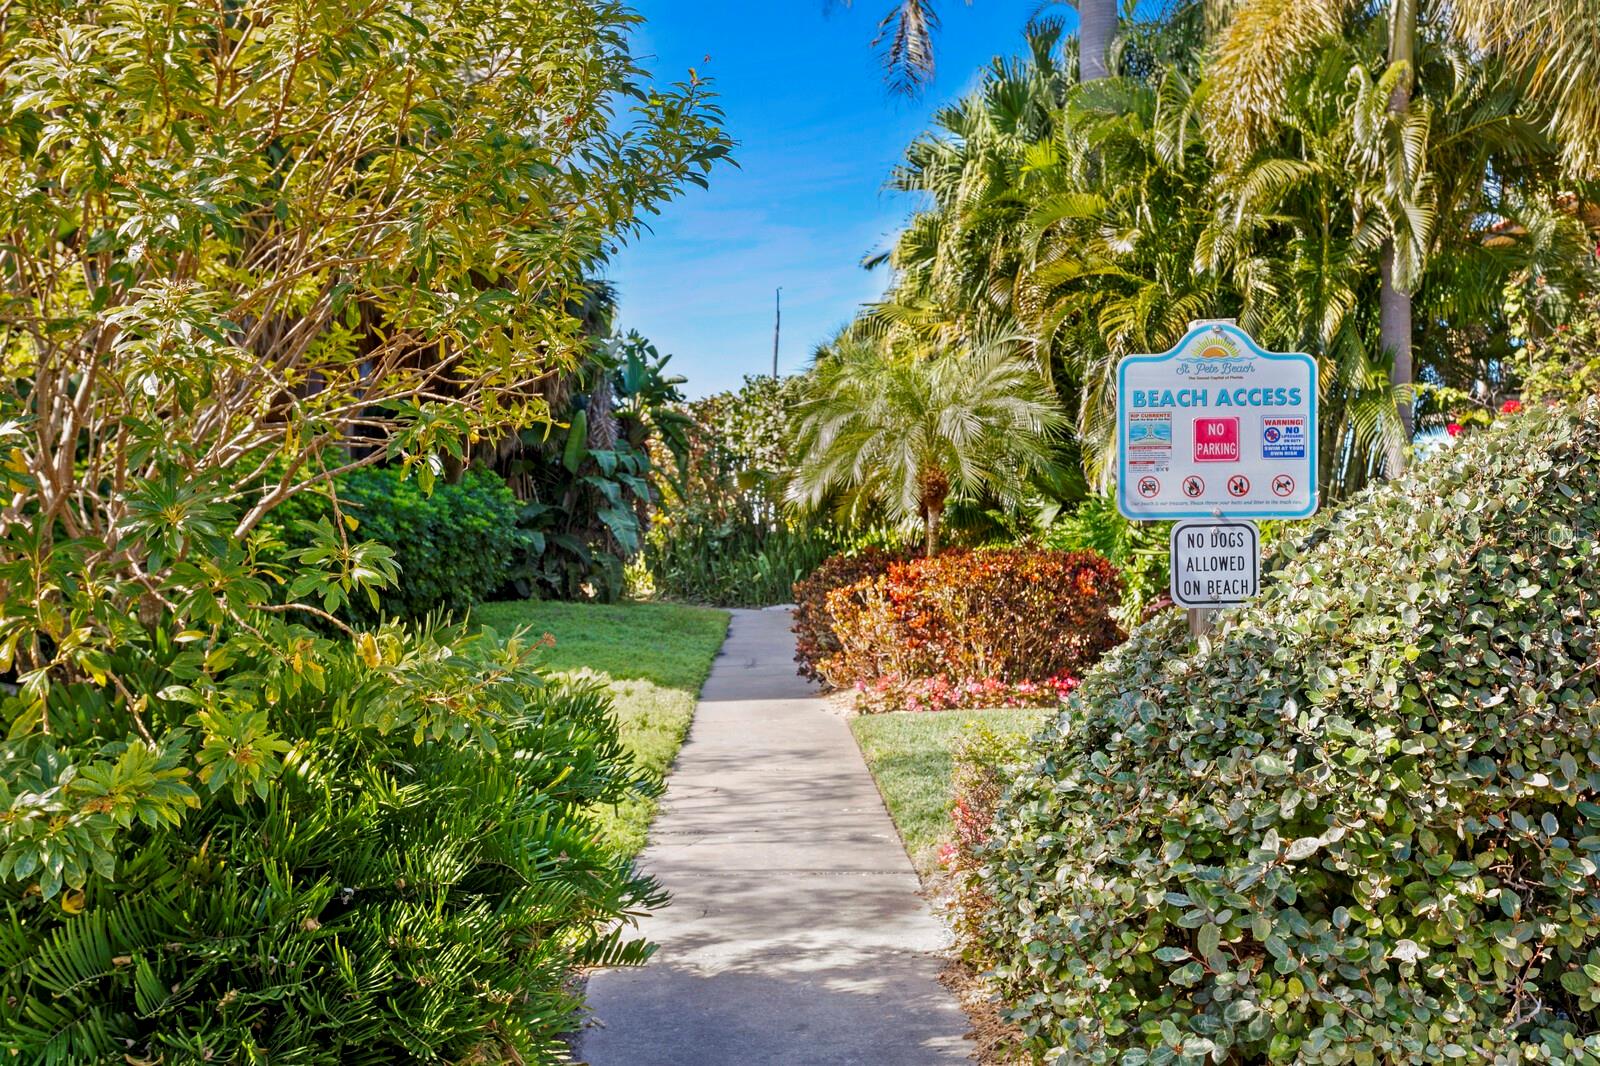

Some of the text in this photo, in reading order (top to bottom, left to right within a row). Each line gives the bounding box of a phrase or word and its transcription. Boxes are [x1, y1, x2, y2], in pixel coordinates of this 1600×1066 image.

[1194, 362, 1219, 375] Pete
[1221, 362, 1256, 375] Beach
[1132, 387, 1302, 408] BEACH ACCESS
[1208, 423, 1225, 436] NO
[1285, 426, 1300, 434] NO
[1197, 442, 1236, 456] PARKING
[1187, 532, 1244, 549] NO DOGS
[1186, 555, 1245, 572] ALLOWED
[1183, 579, 1249, 596] ON BEACH
